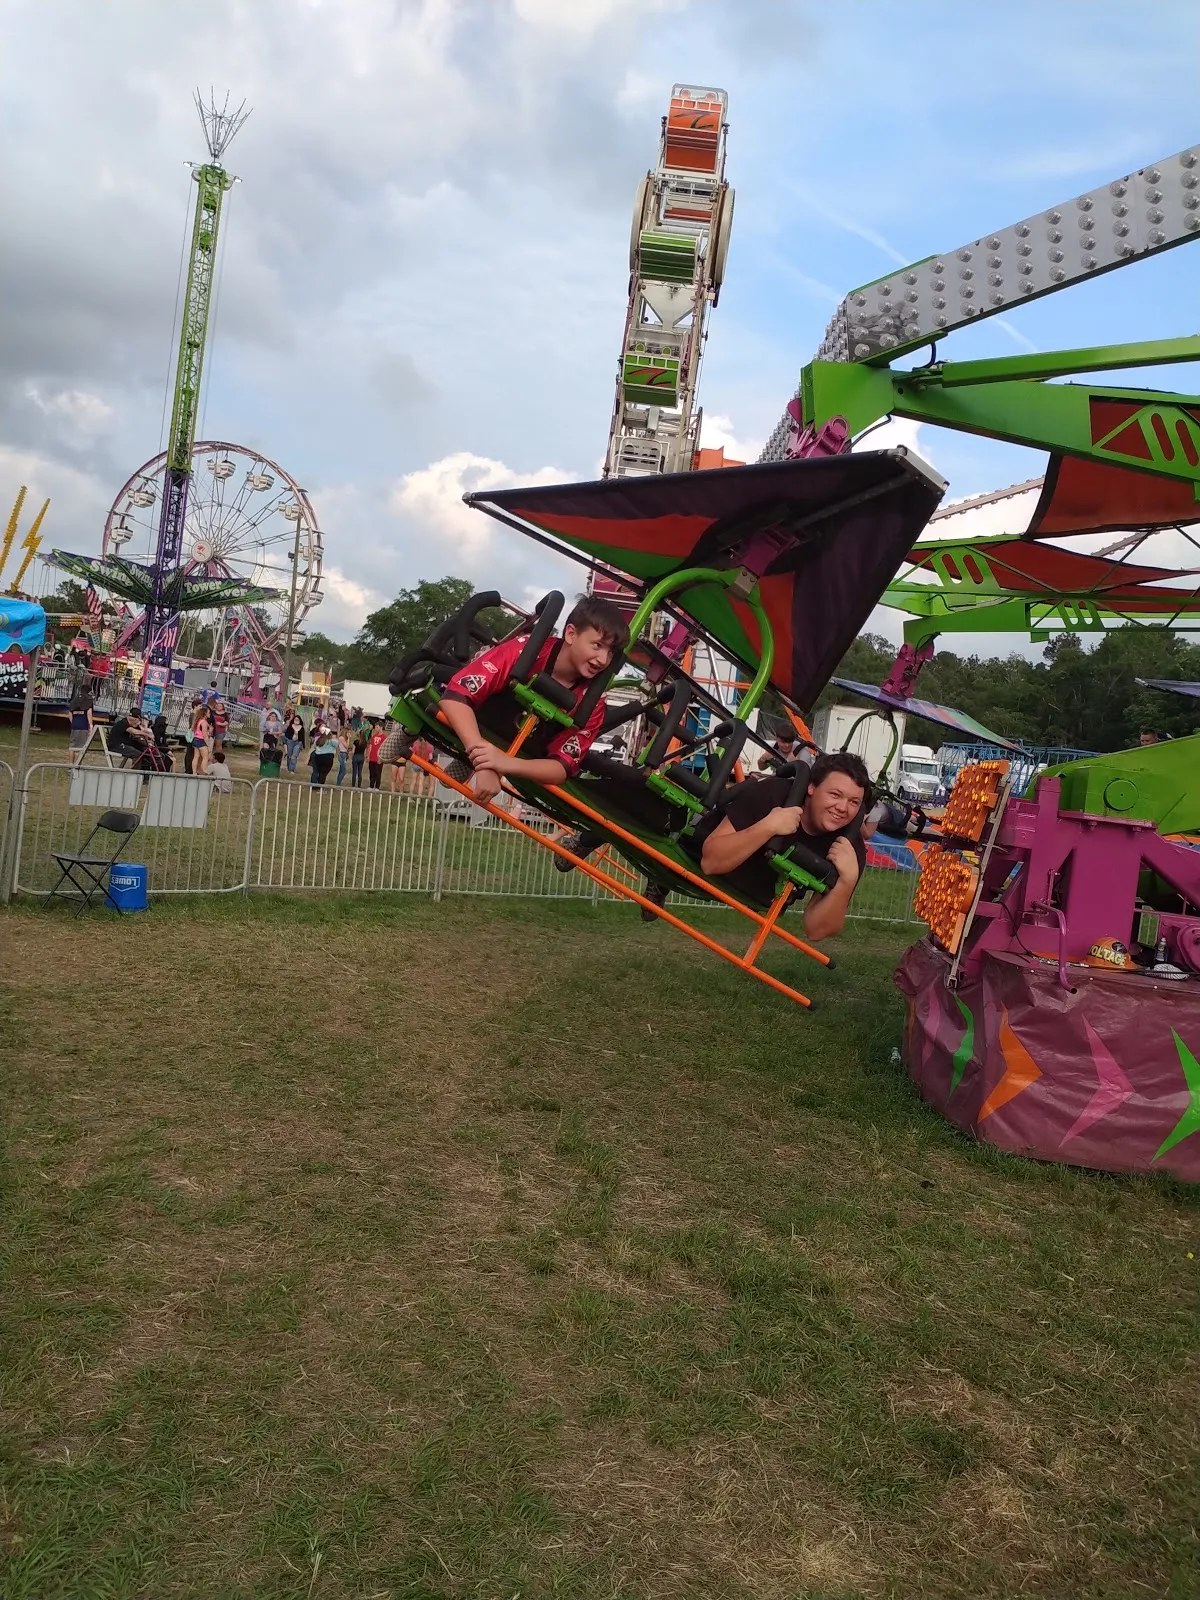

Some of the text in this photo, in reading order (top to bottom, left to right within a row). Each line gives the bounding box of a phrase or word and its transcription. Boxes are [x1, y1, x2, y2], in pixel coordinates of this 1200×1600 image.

[90, 560, 133, 587] Swing
[130, 564, 155, 588] Swing
[184, 580, 222, 594] Tower
[211, 587, 248, 598] wer
[1088, 944, 1127, 966] OLTAGE
